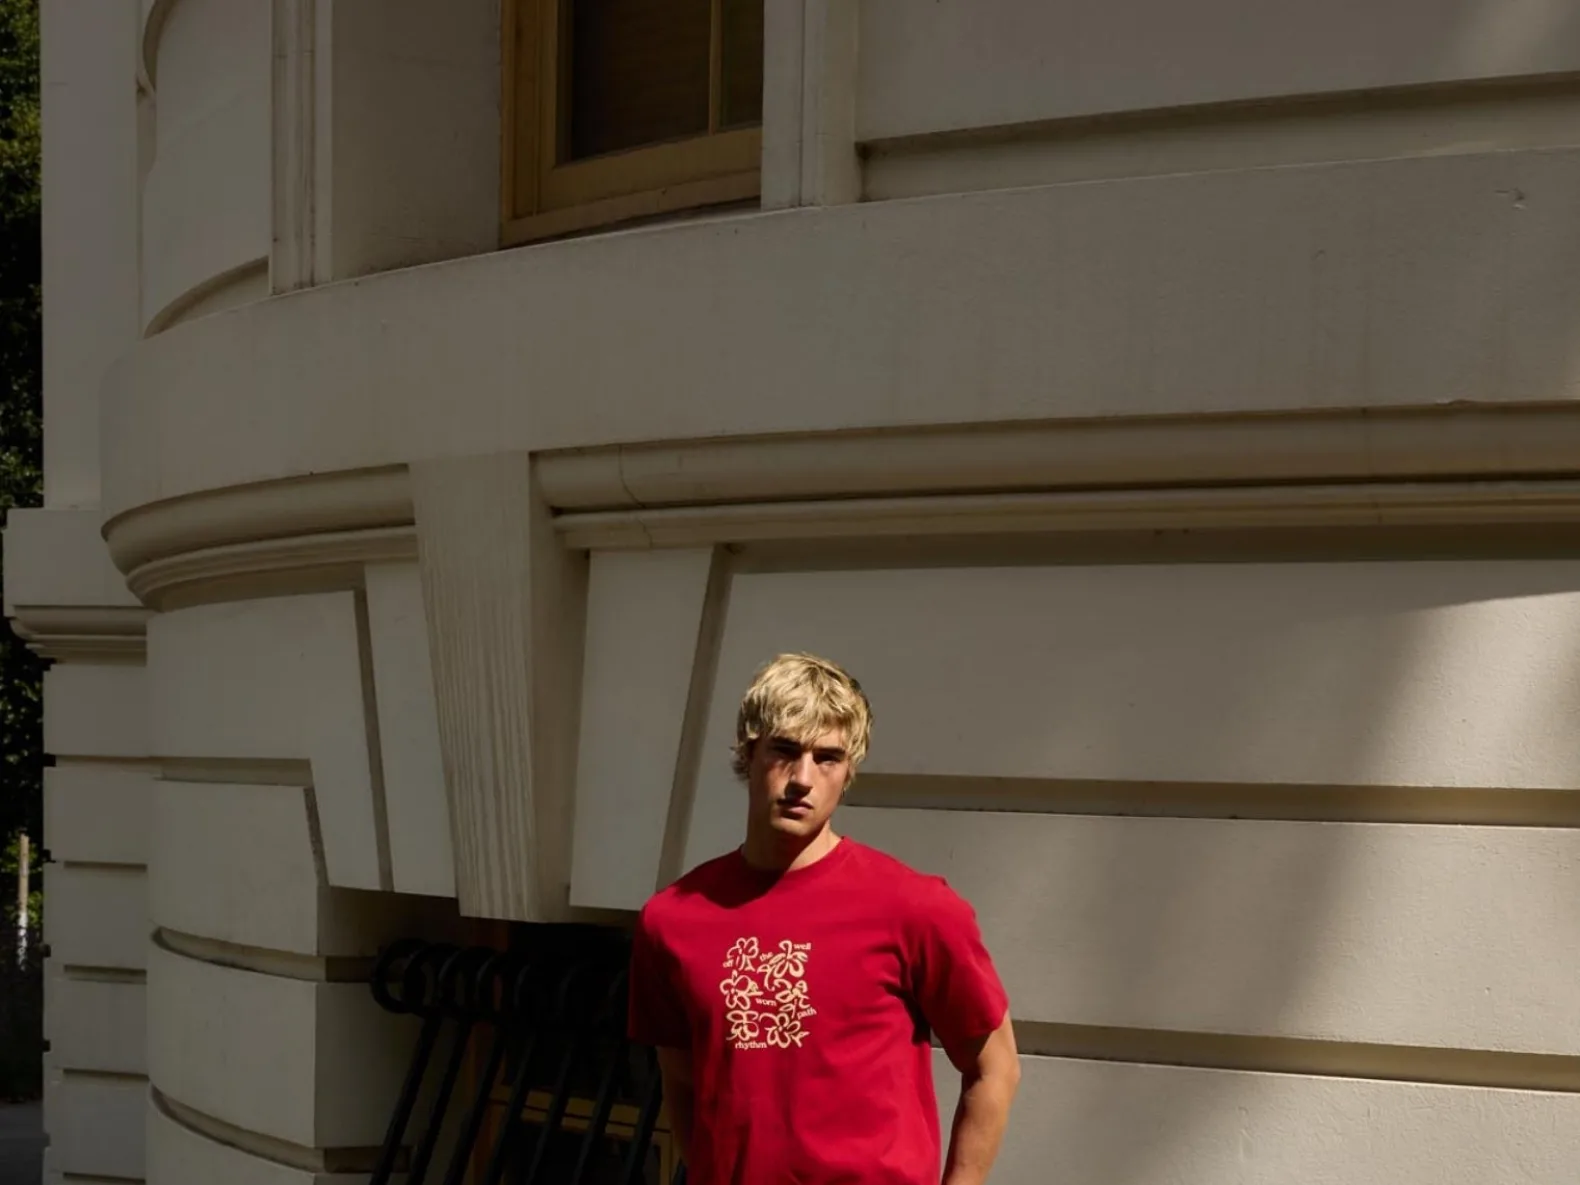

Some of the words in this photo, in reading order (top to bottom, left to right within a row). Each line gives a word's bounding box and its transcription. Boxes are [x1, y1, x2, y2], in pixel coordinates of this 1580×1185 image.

[760, 952, 773, 962] the
[755, 998, 777, 1006] worn
[797, 1007, 817, 1020] path
[735, 1041, 767, 1050] rhythm
